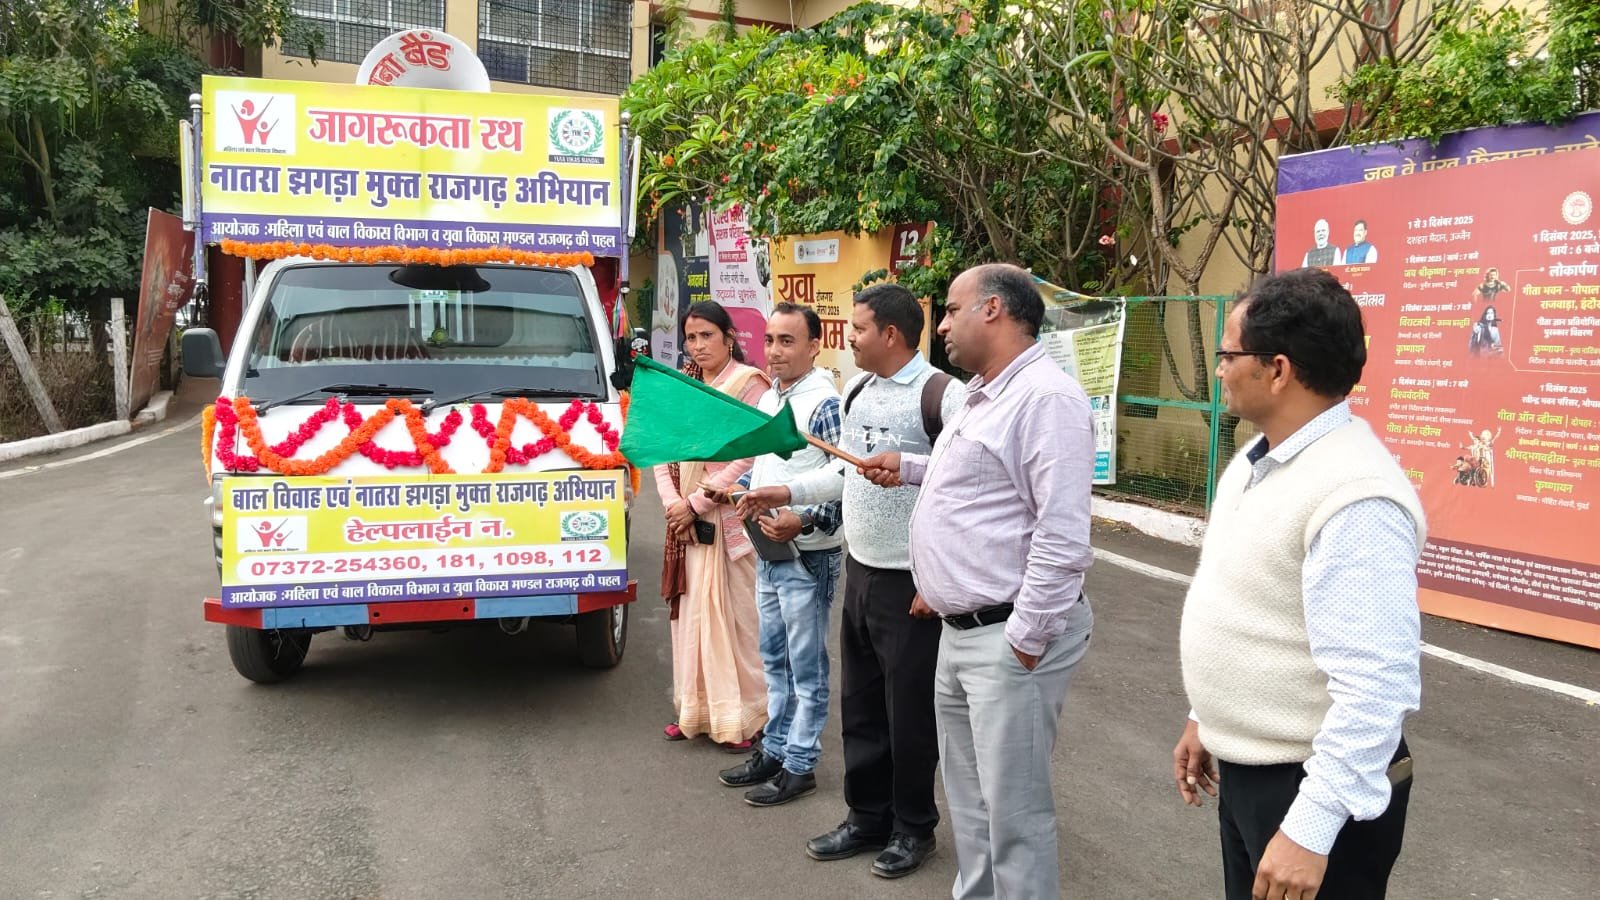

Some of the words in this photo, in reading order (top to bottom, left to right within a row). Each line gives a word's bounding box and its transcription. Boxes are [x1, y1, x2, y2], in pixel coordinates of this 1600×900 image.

[367, 53, 408, 86] ना
[400, 31, 453, 71] बैंड
[308, 110, 472, 150] जागरूकता
[480, 119, 524, 151] रथ
[209, 164, 281, 193] नातरा
[287, 168, 360, 203] झगड़ा
[365, 171, 421, 208] मुक्त
[427, 173, 508, 209] राजगढ़
[515, 171, 610, 206] अभियान
[1362, 167, 1396, 182] जब
[211, 218, 260, 236] आयोजक
[308, 219, 324, 239] एवं
[327, 225, 350, 239] बाल
[354, 221, 391, 241] विकास
[395, 222, 428, 242] विभाग
[432, 228, 440, 241] व
[442, 229, 463, 247] युवा
[466, 226, 500, 245] विकास
[502, 231, 535, 245] मण्डल
[538, 233, 573, 250] राजगढ़
[575, 230, 589, 247] की
[592, 233, 616, 248] पहल
[1407, 221, 1413, 229] 1
[1413, 218, 1421, 229] से
[1422, 220, 1427, 228] 3
[1428, 215, 1452, 228] दिसंबर
[1454, 215, 1474, 225] 2025
[1533, 233, 1537, 242] 1
[1540, 229, 1568, 242] दिसंबर
[1570, 231, 1597, 241] 2025,
[899, 230, 920, 257] 12
[1549, 243, 1568, 256] सायं
[1576, 245, 1582, 254] 6
[1584, 242, 1600, 254] बजे
[1549, 260, 1598, 278] लोकार्पण
[1522, 283, 1541, 296] गीता
[1571, 282, 1599, 295] गोपाल
[1545, 382, 1567, 393] दिसंबर
[1568, 385, 1588, 394] 2025
[1498, 408, 1516, 422] गीता
[1518, 410, 1534, 424] ऑन
[232, 488, 269, 510] बाल
[273, 482, 323, 509] विवाह
[326, 480, 352, 508] एवं
[355, 485, 401, 508] नातरा
[405, 484, 451, 509] झगड़ा
[456, 482, 491, 511] मुक्त
[496, 481, 549, 507] राजगढ़
[553, 475, 616, 502] अभियान
[346, 515, 473, 543] हेल्पलाईन
[251, 555, 428, 577] 07372-254360,
[436, 553, 485, 569] 181,
[493, 550, 554, 568] 1098,
[562, 549, 602, 564] 112
[229, 588, 277, 604] आयोजक
[323, 584, 339, 600] एवं
[342, 586, 363, 599] बाल
[367, 582, 403, 598] विकास
[406, 580, 440, 596] विभाग
[443, 584, 450, 594] व
[453, 583, 473, 597] युवा
[475, 578, 509, 593] विकास
[511, 578, 543, 591] मण्डल
[545, 577, 579, 590] राजगढ़
[581, 573, 595, 587] की
[597, 575, 621, 586] पहल
